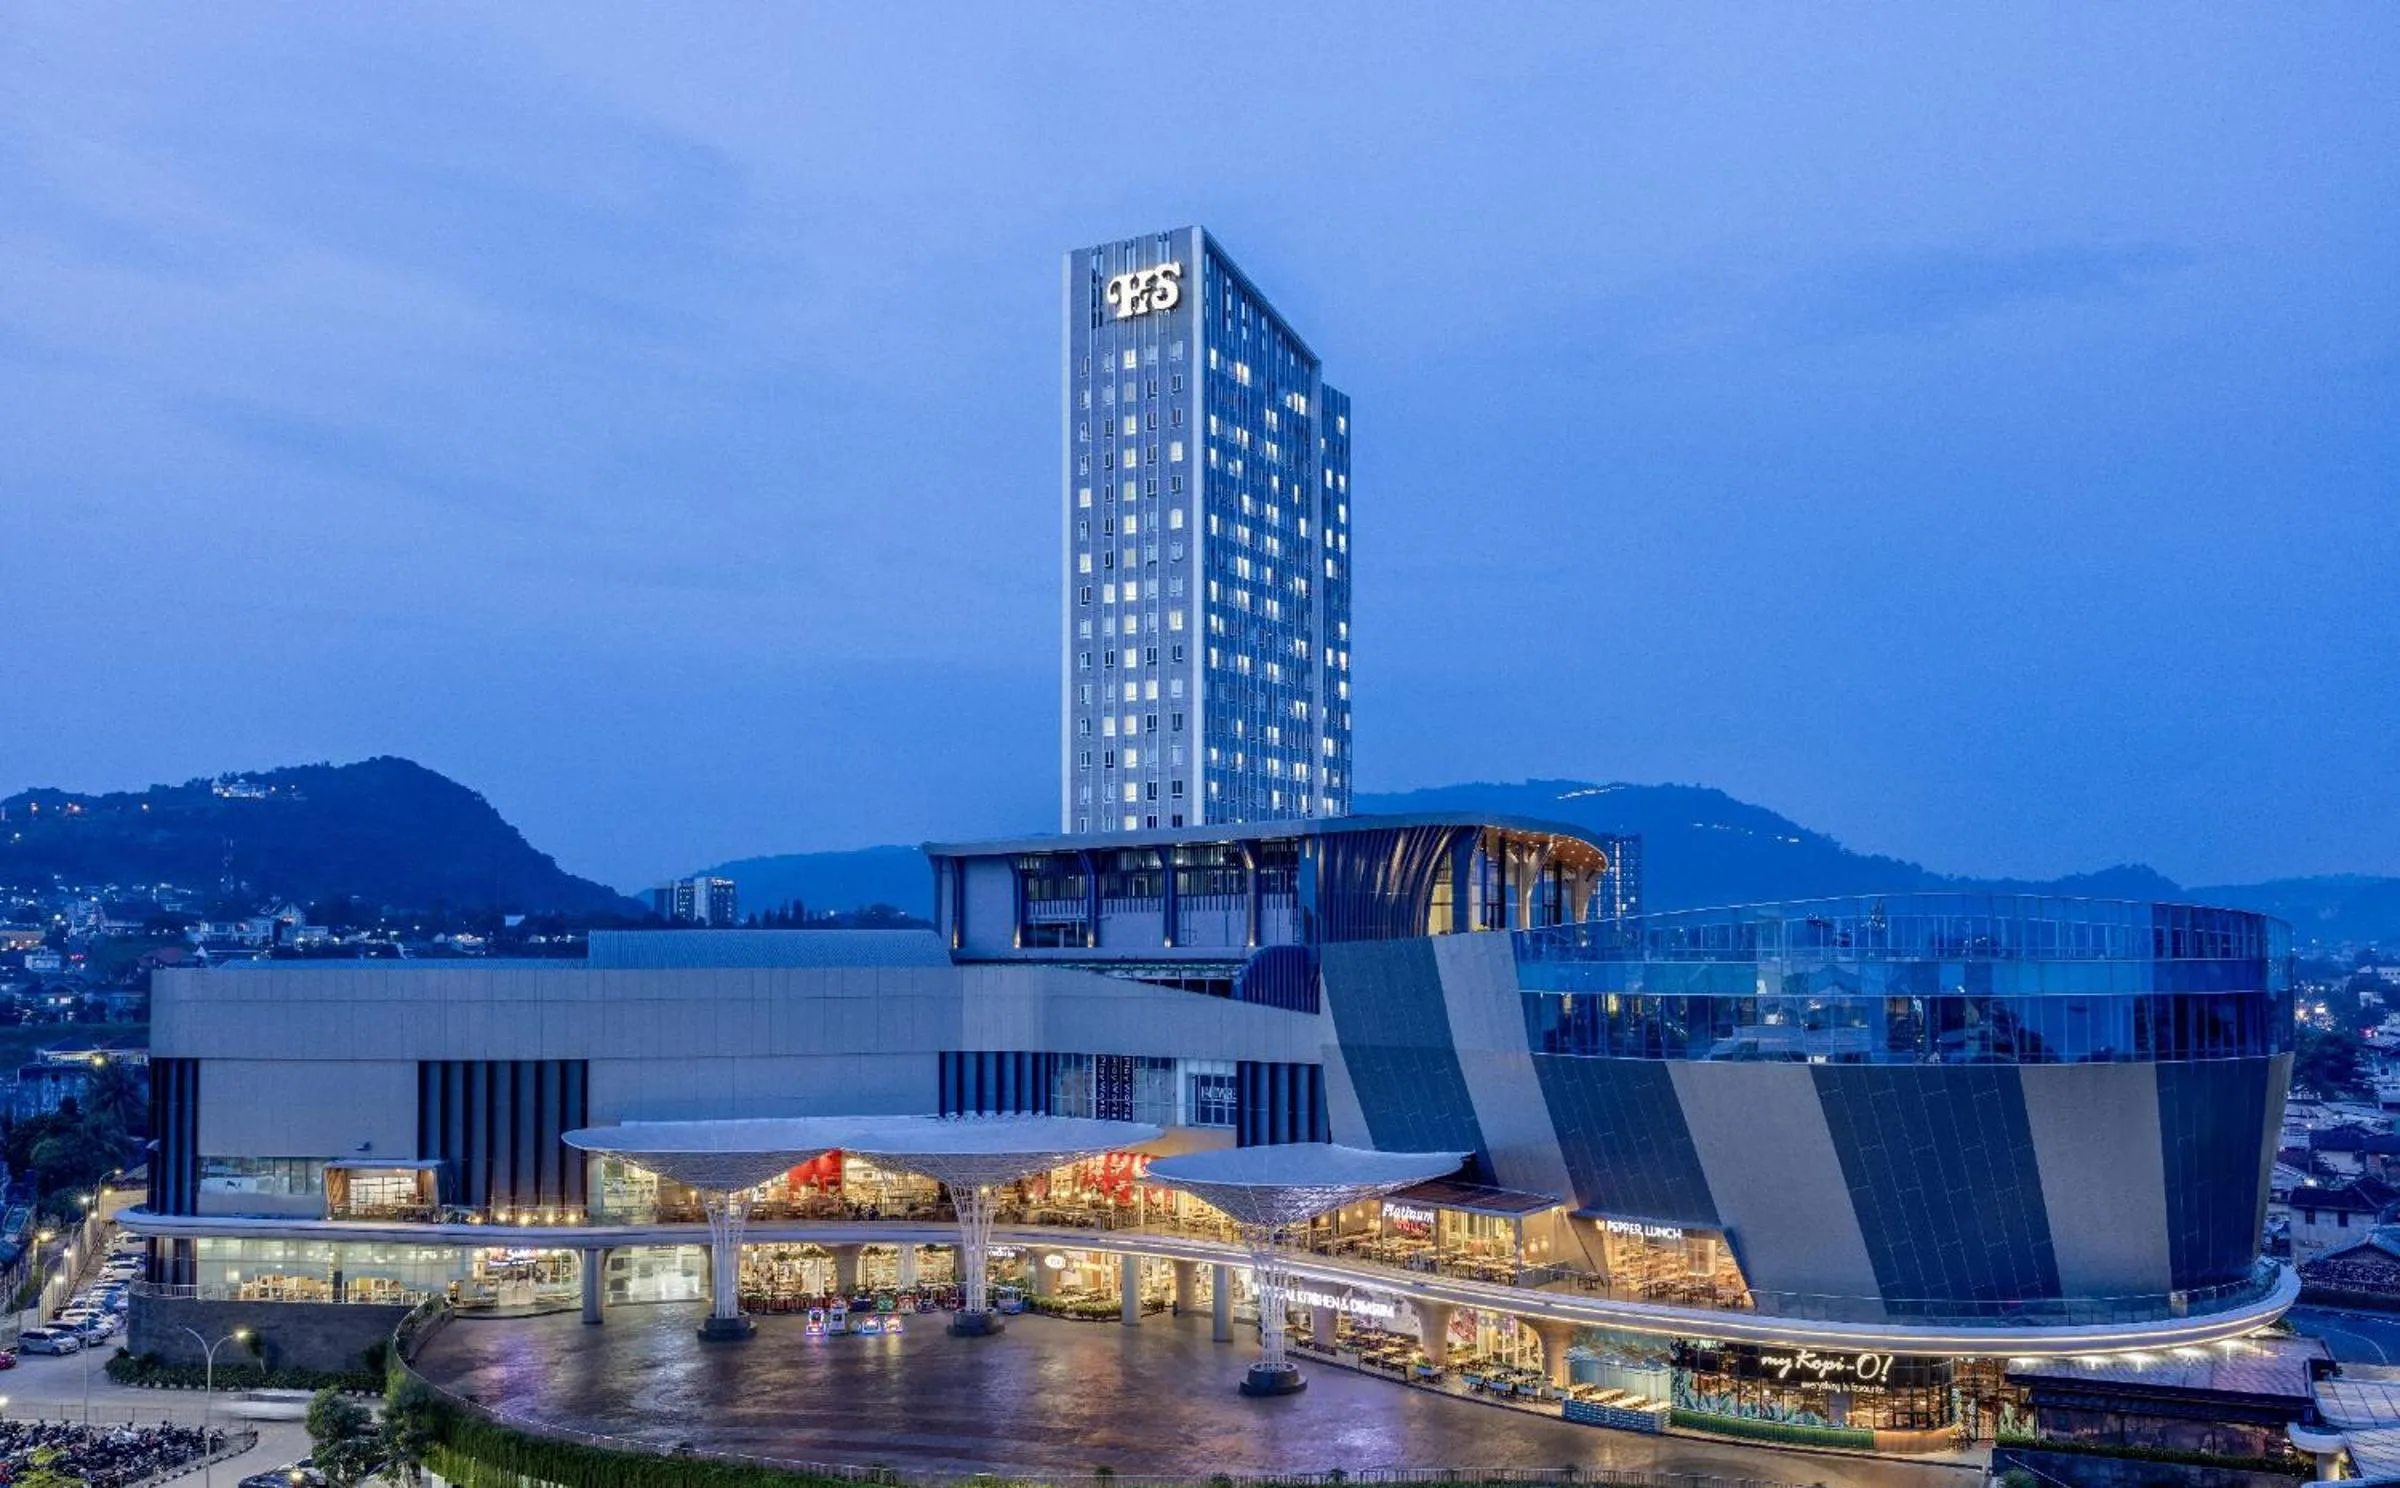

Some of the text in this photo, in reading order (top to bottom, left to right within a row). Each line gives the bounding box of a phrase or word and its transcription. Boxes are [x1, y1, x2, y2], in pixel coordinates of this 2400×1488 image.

[1382, 1203, 1435, 1224] Platinum
[1607, 1220, 1683, 1239] PEPPER LUNCH
[1761, 1356, 1792, 1378] my
